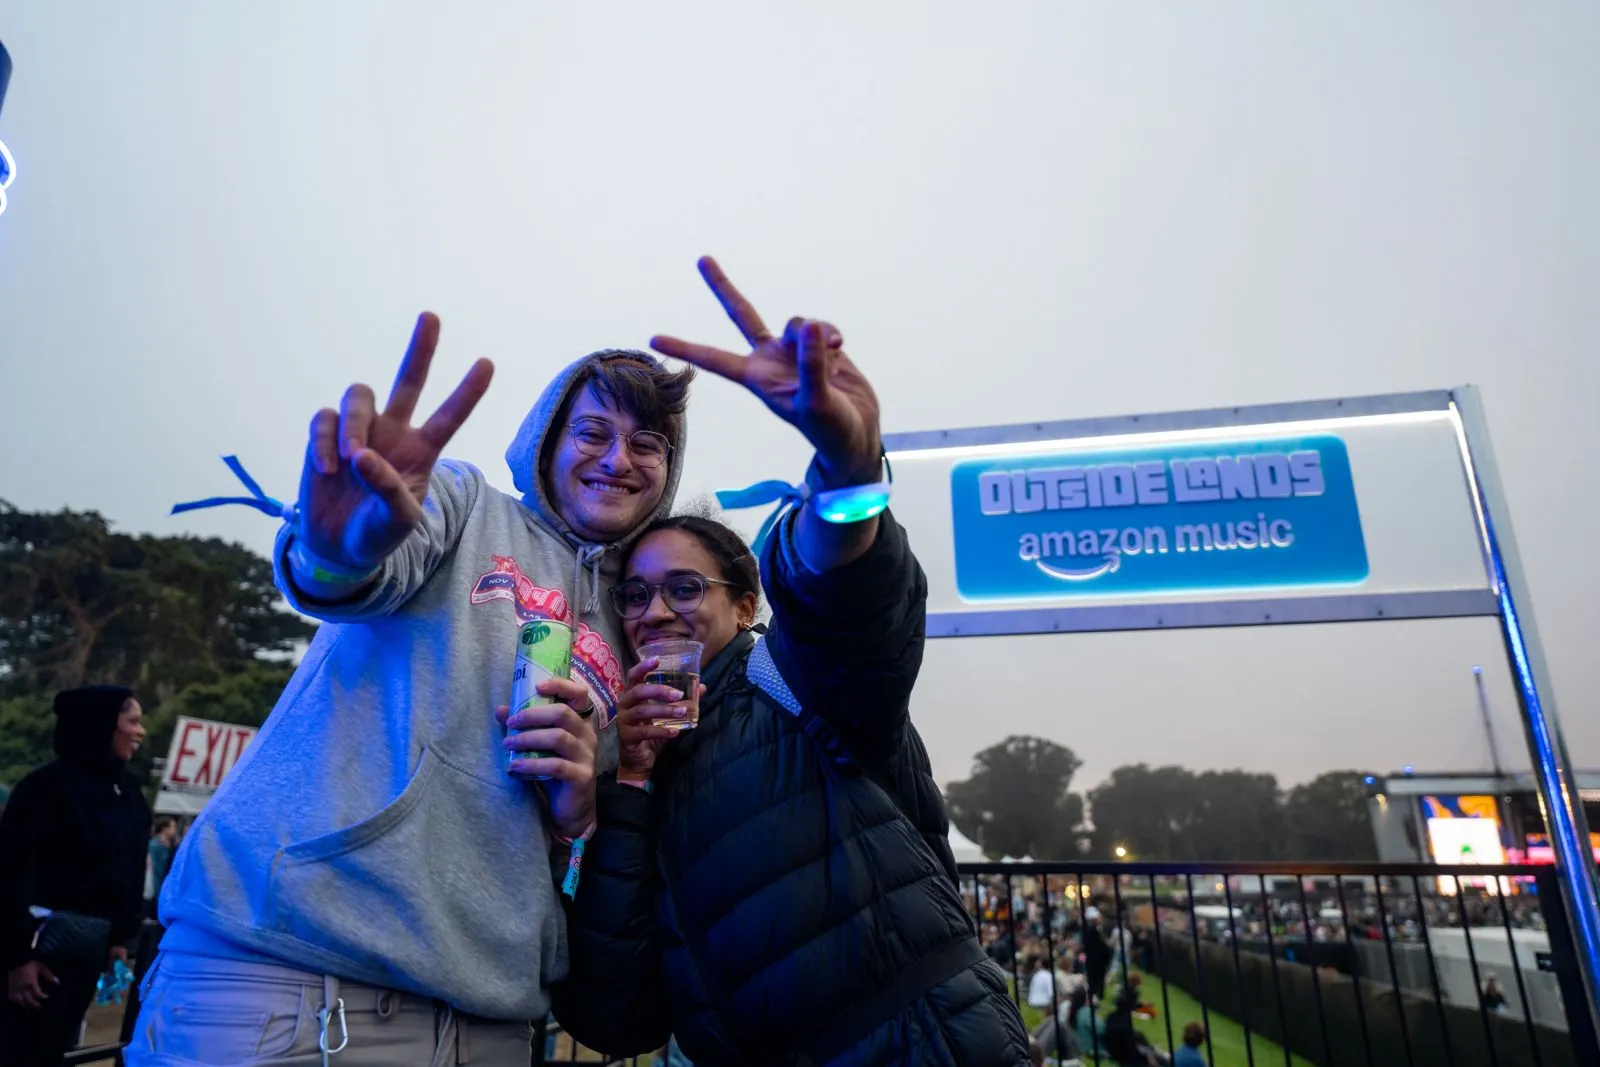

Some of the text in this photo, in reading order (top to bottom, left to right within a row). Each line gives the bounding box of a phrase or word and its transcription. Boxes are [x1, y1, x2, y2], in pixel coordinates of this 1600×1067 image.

[979, 450, 1325, 516] OUTSIDE LANDS
[1018, 512, 1295, 560] amazon music
[170, 722, 251, 785] EXIT
